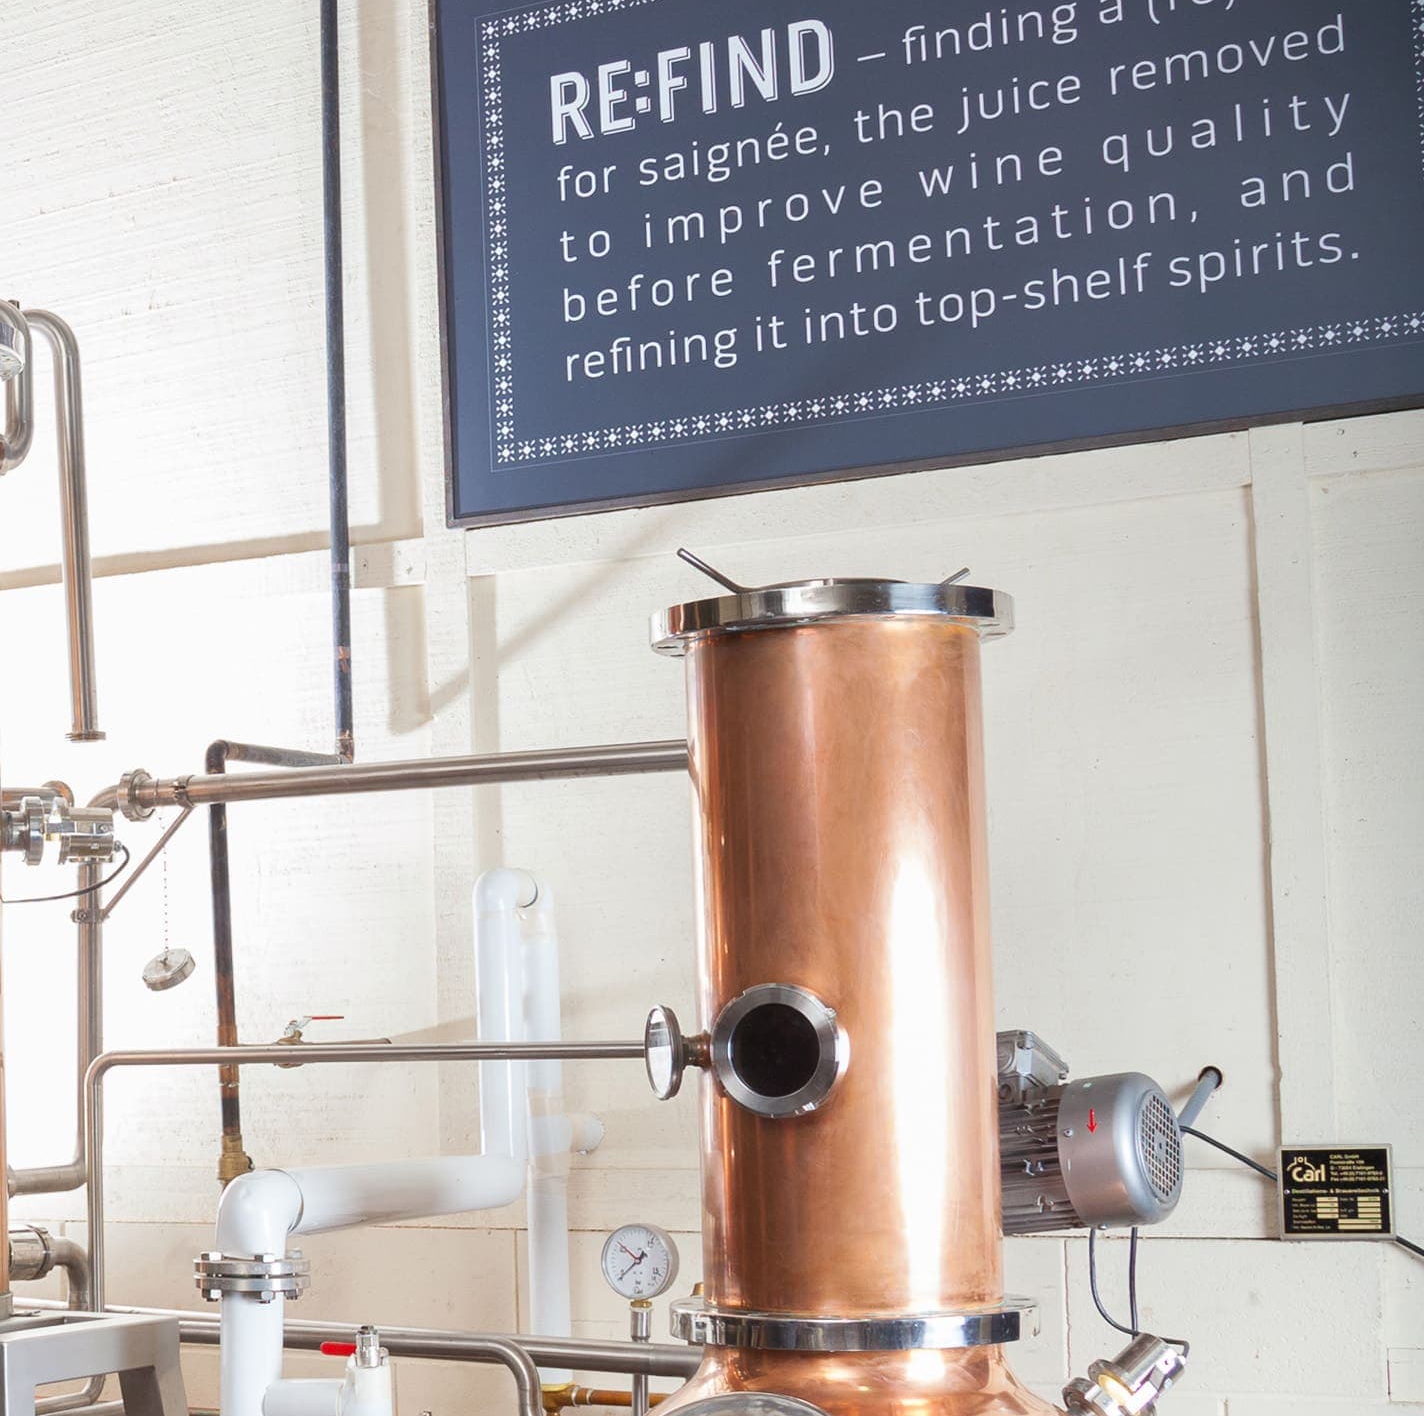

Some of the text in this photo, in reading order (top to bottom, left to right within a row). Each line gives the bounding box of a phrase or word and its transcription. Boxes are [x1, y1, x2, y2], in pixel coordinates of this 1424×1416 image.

[550, 19, 836, 146] RE:FIND
[902, 2, 1079, 66] finding
[556, 13, 1345, 202] for saignée, the juice removed
[559, 93, 1351, 264] to improve wine quality
[563, 152, 1355, 324] before fermentation, and
[566, 230, 1361, 383] refining it into top-shelf spirits.
[1291, 1164, 1326, 1182] Carl
